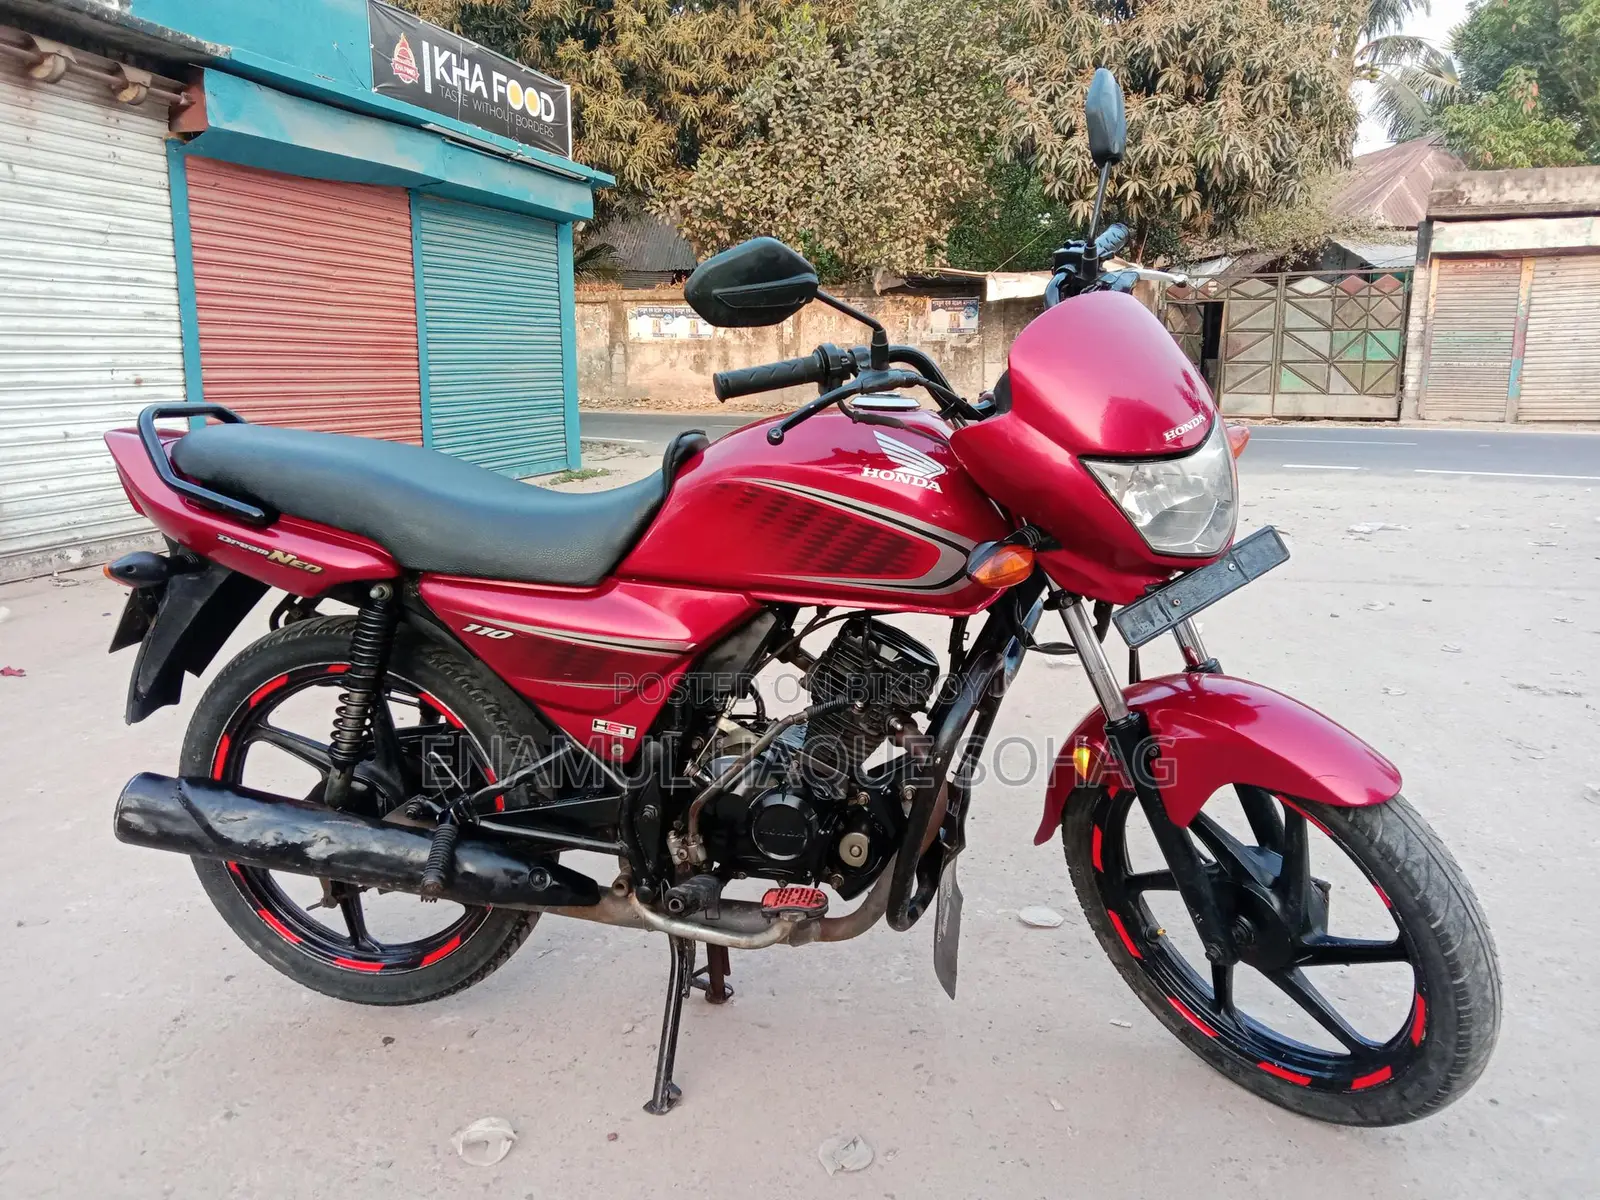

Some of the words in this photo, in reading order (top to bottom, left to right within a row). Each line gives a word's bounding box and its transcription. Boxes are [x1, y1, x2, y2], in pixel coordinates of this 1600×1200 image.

[492, 70, 555, 123] FOOD
[439, 84, 469, 108] TASTE
[472, 97, 514, 123] WITHOUT
[515, 114, 555, 138] BORDERS
[1163, 413, 1206, 442] HONDA
[861, 466, 943, 494] HONDA
[217, 533, 270, 556] Dream
[461, 623, 514, 640] 110
[593, 720, 635, 735] HET
